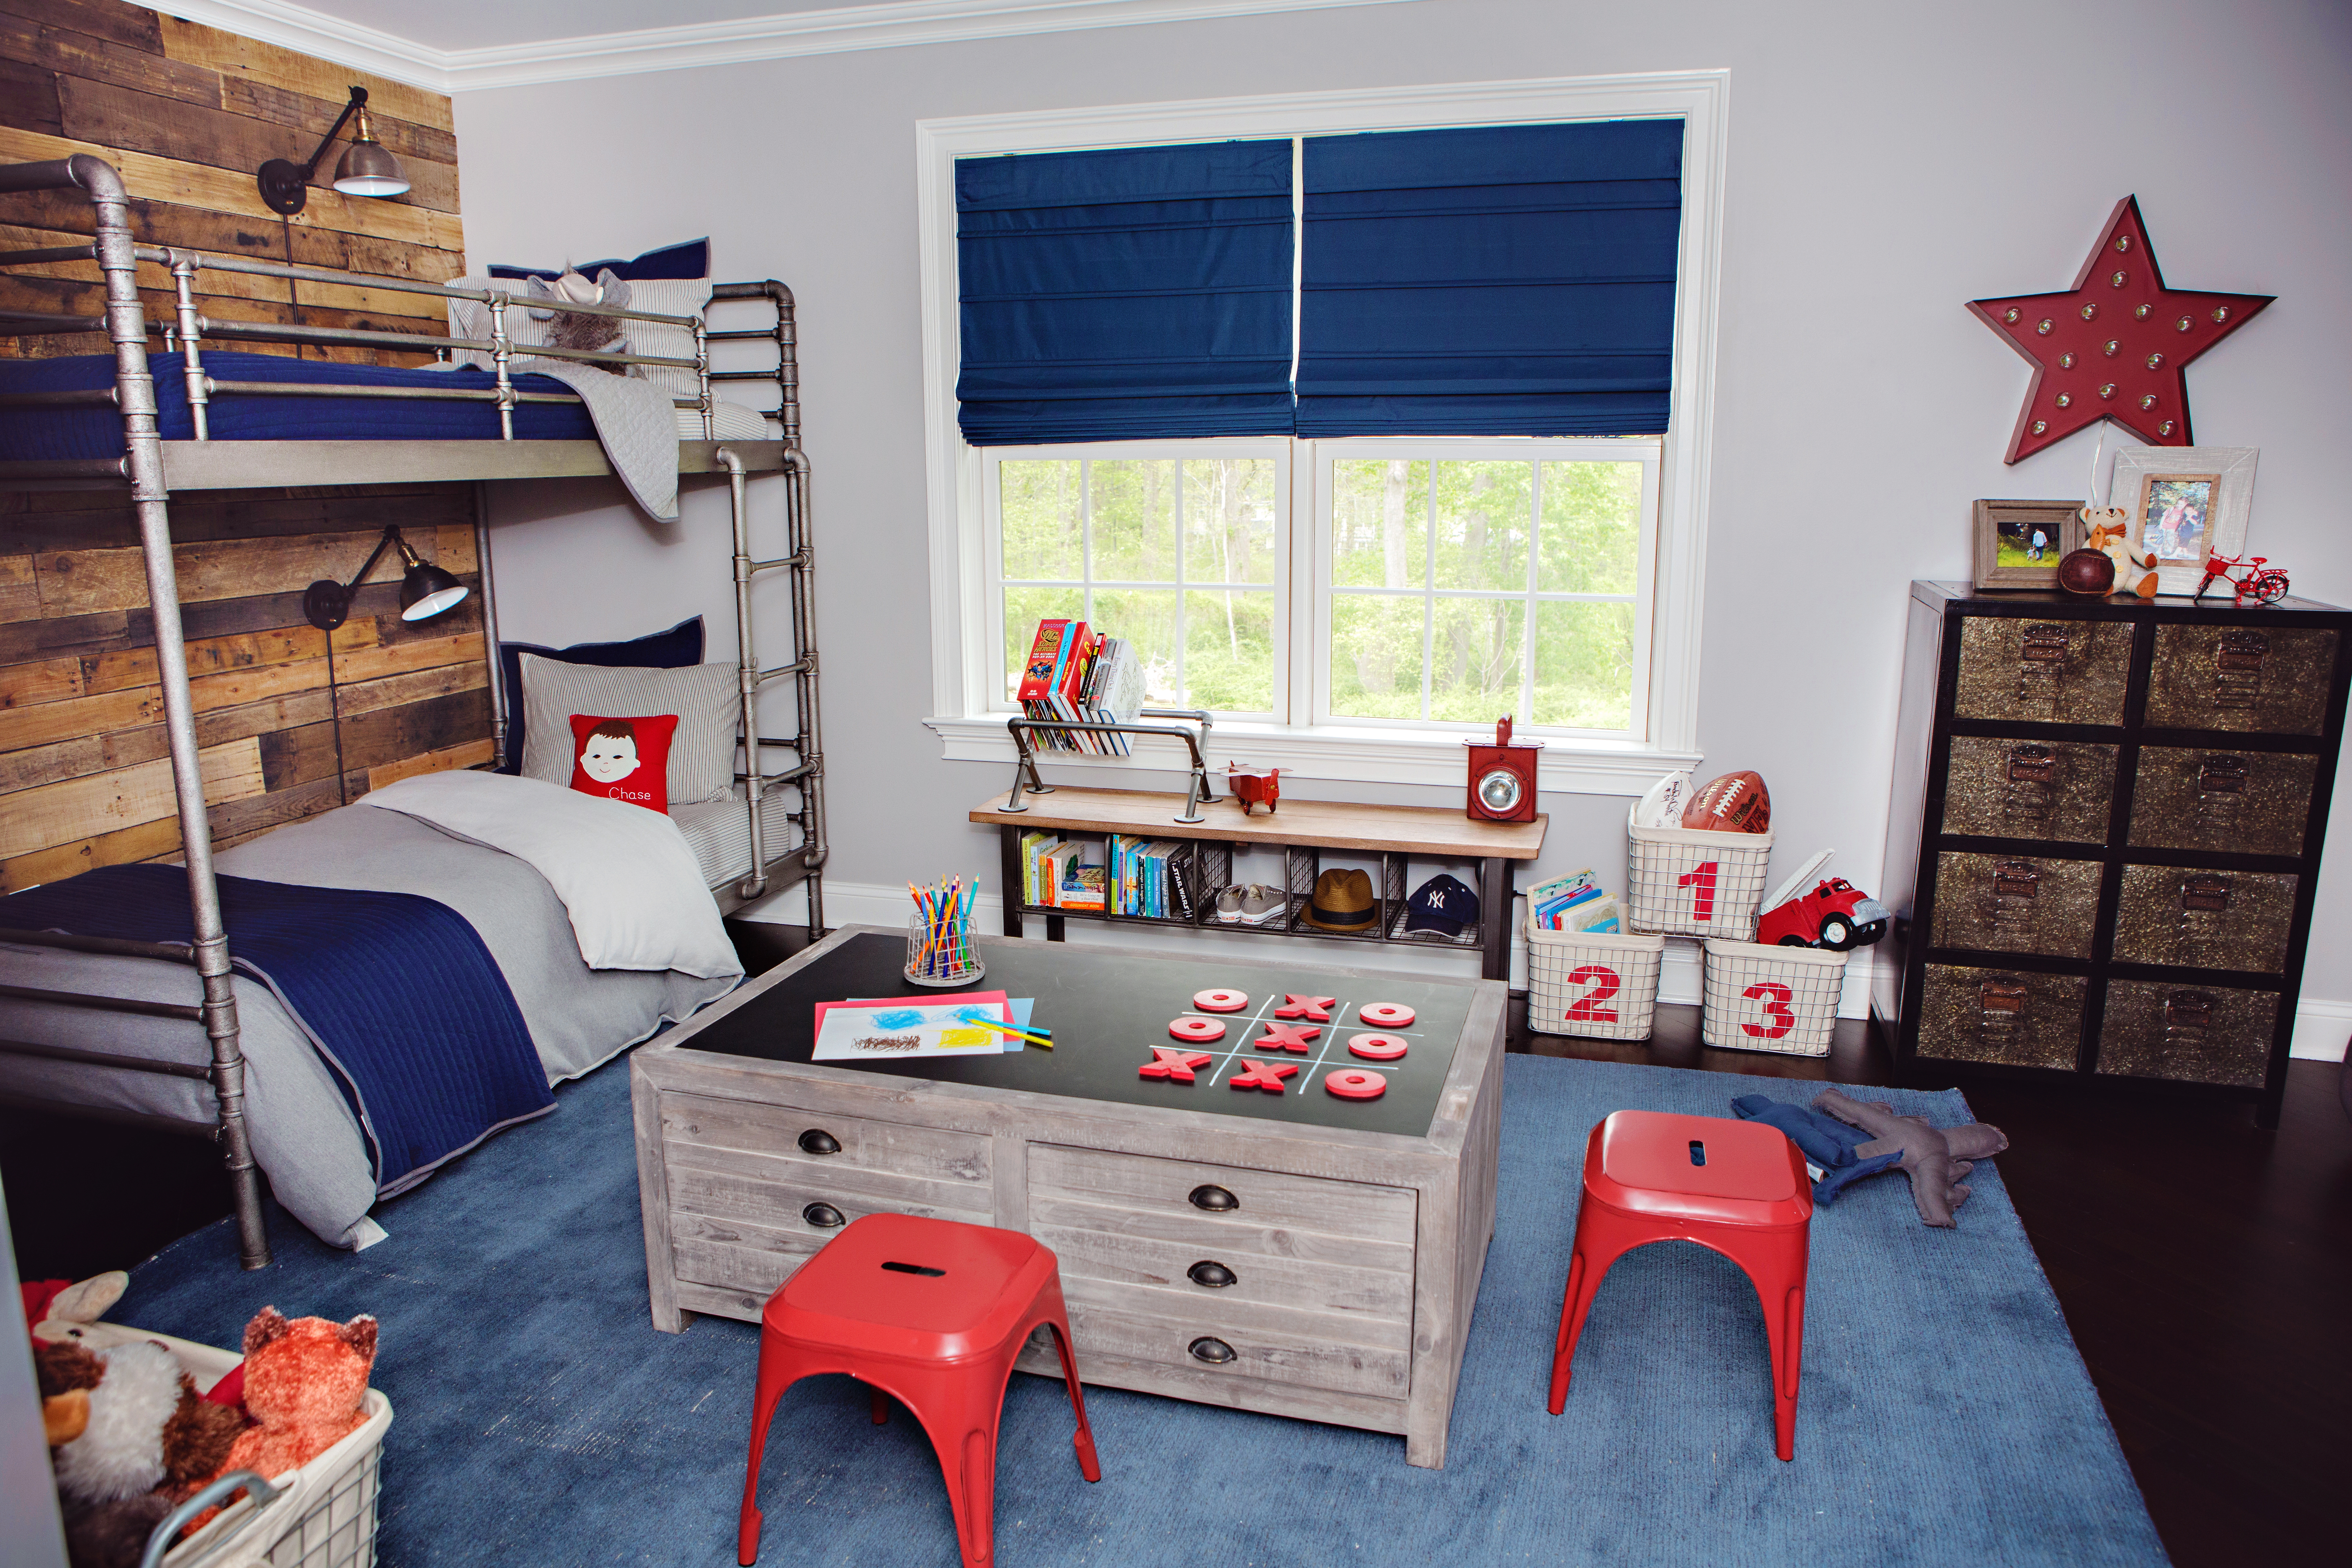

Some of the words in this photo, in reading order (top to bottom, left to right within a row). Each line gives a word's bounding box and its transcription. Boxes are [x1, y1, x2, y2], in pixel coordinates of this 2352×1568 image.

[1108, 667, 1117, 680] Thing
[1111, 656, 1120, 668] Every
[609, 787, 651, 800] Chase
[1700, 779, 1727, 808] Wilson
[1730, 793, 1759, 825] Wilson
[1172, 865, 1183, 888] STAR
[1179, 888, 1189, 910] WARS
[1427, 890, 1445, 909] NY
[1678, 862, 1718, 921] 1
[1565, 965, 1620, 1023] 2
[1741, 982, 1795, 1039] 3
